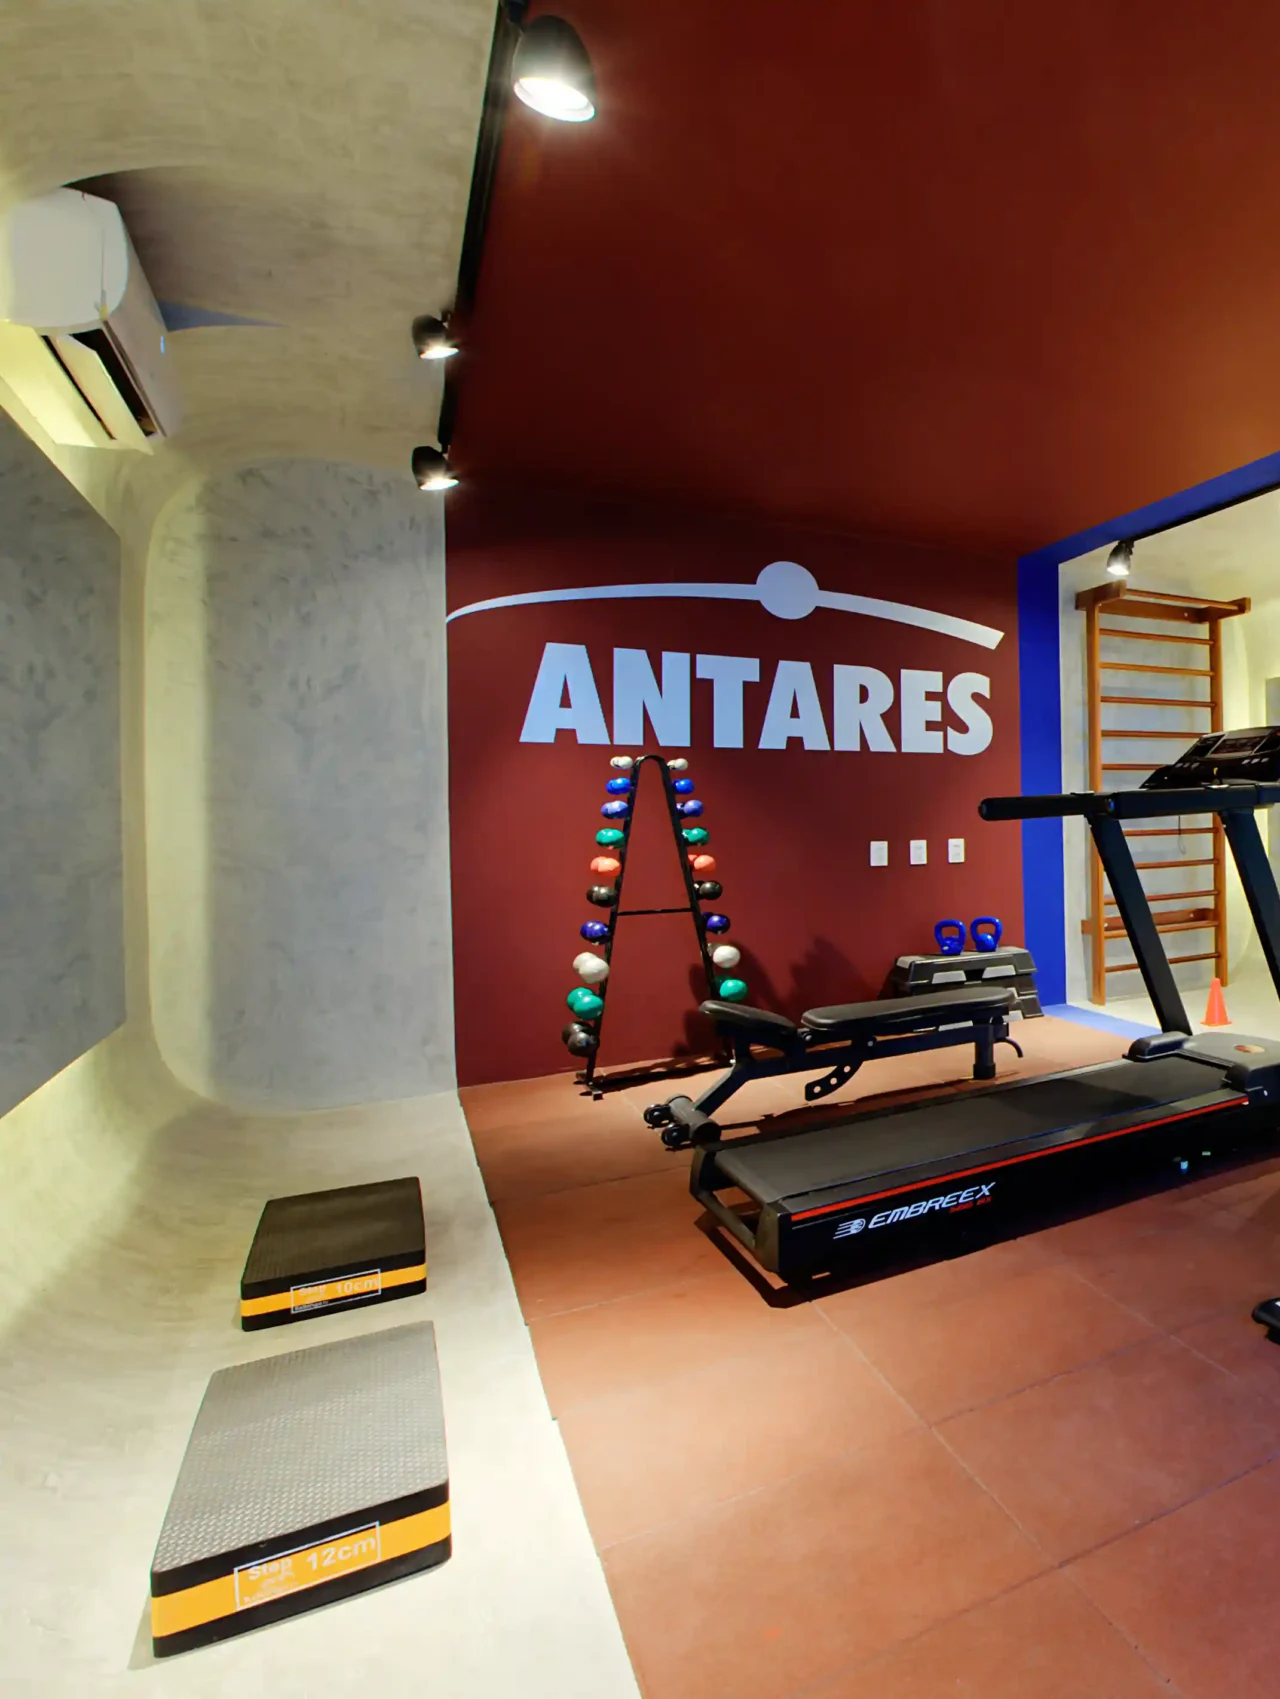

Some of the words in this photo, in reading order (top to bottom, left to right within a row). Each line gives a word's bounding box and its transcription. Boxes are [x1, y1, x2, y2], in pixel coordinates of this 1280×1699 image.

[519, 642, 994, 756] ANTARES
[868, 1181, 996, 1229] EMBREEX
[306, 1536, 377, 1571] 12cm
